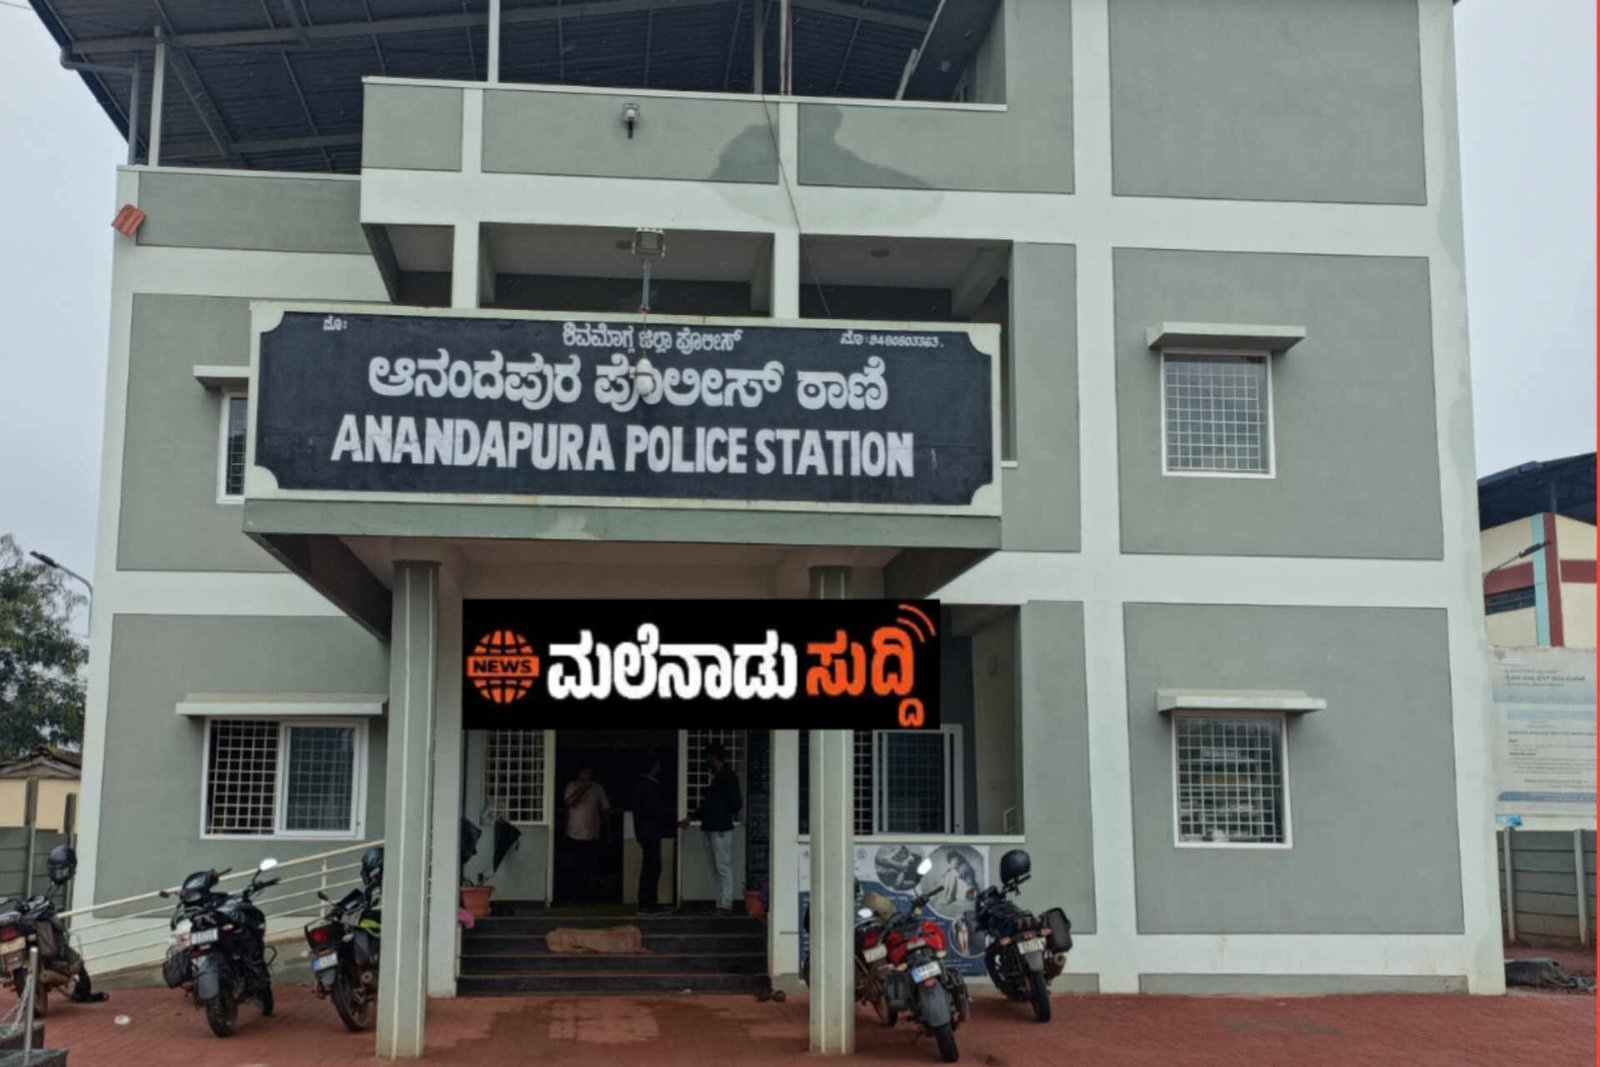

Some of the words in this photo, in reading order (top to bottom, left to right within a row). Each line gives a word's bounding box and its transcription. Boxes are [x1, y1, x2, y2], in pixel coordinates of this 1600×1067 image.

[563, 321, 636, 353] ಶಿವಮೊಗ್ಗ
[368, 348, 582, 411] ಆನಂದಪುರ
[796, 355, 889, 411] ಠಾಣೆ
[329, 413, 616, 471] ANANDAPURA
[624, 424, 748, 474] POLICE
[754, 428, 915, 478] STATION
